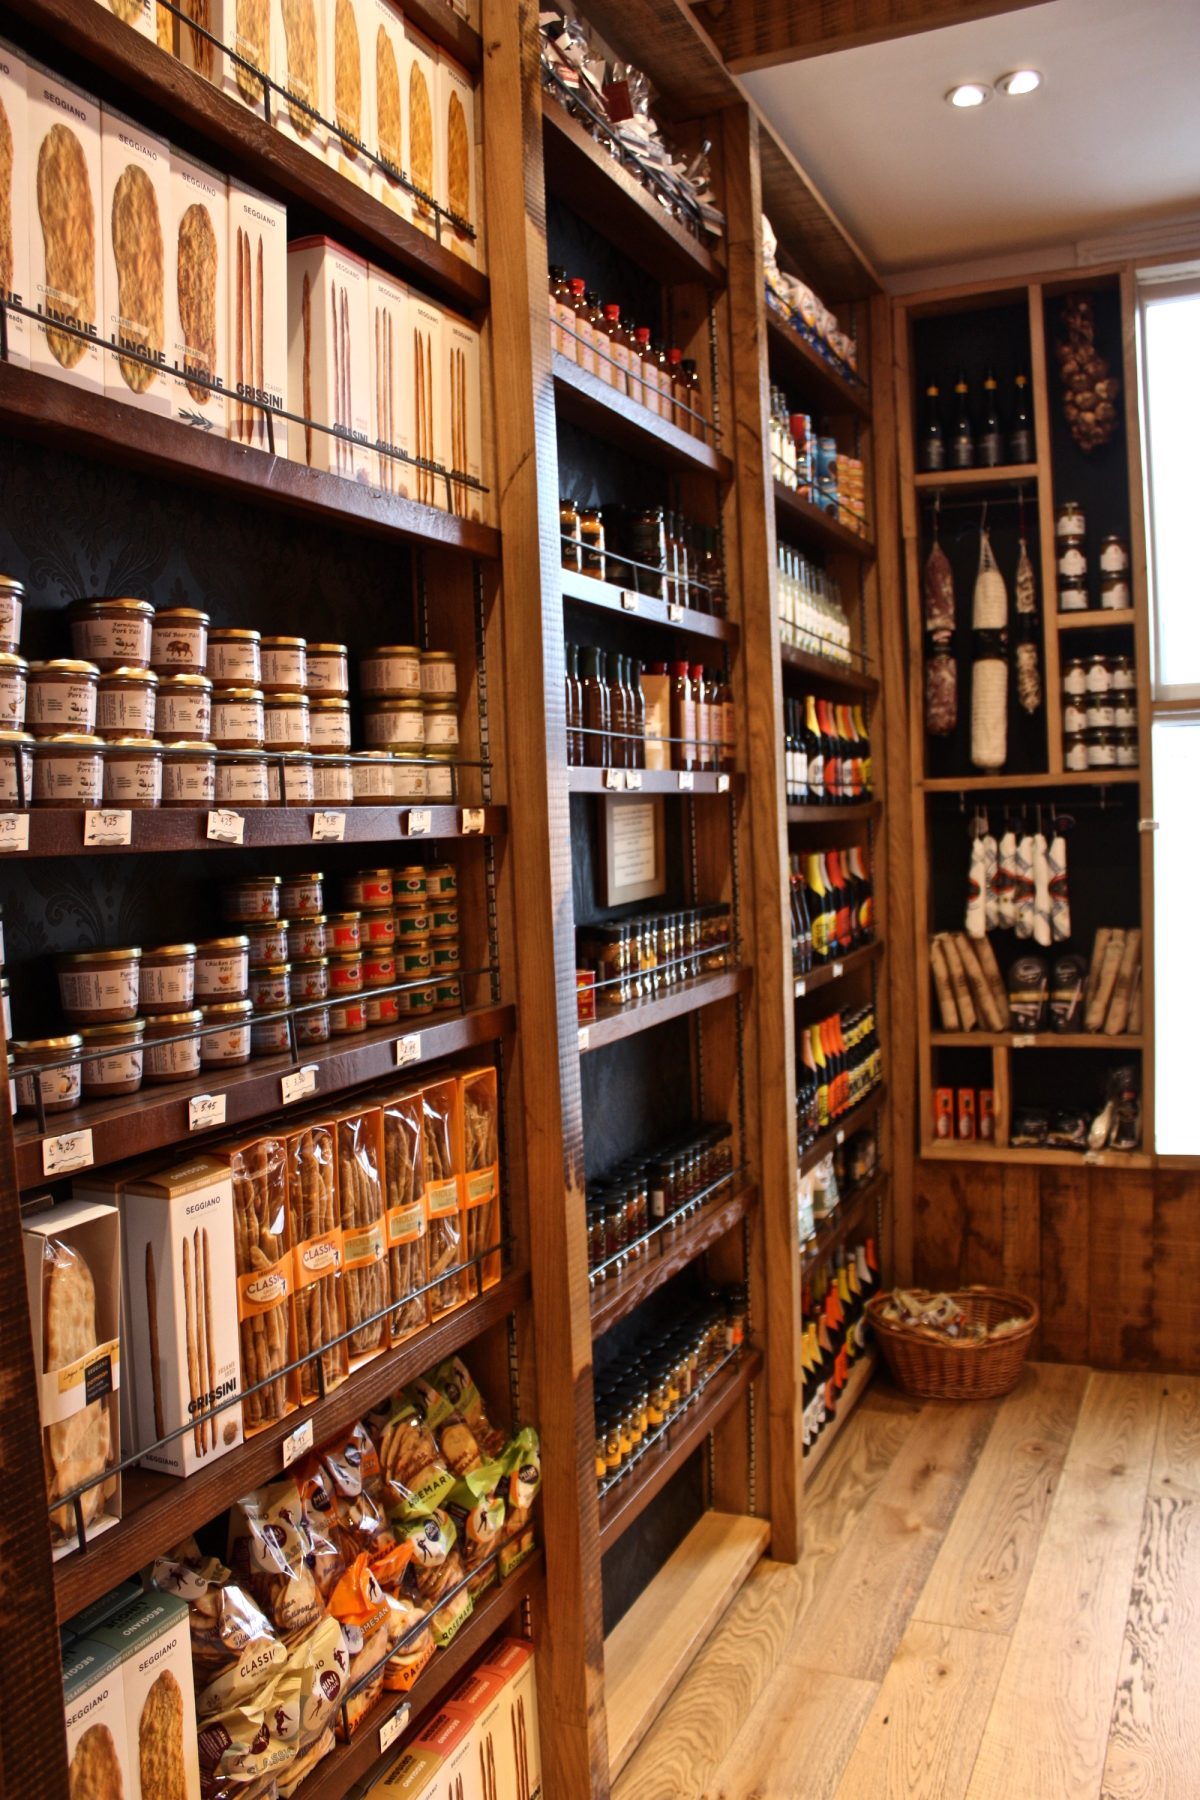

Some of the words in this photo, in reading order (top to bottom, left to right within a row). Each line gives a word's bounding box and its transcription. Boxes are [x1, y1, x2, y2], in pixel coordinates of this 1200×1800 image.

[43, 90, 87, 122] SEGGIANO
[118, 133, 158, 161] SEGGIANO
[182, 171, 217, 197] SEGGIANO
[243, 204, 276, 227] SEGGIANO
[236, 382, 283, 410] GRISSINI
[186, 1196, 221, 1215] SEGGIANO
[304, 1241, 339, 1262] CLASSIC
[247, 1271, 286, 1294] CLASSIC
[188, 1377, 236, 1414] GRISSINI
[145, 1454, 178, 1467] SEGGIANO
[123, 1606, 164, 1636] SEGGIANO
[139, 1640, 177, 1672] SEGGIANO
[66, 1690, 109, 1727] SEGGIANO
